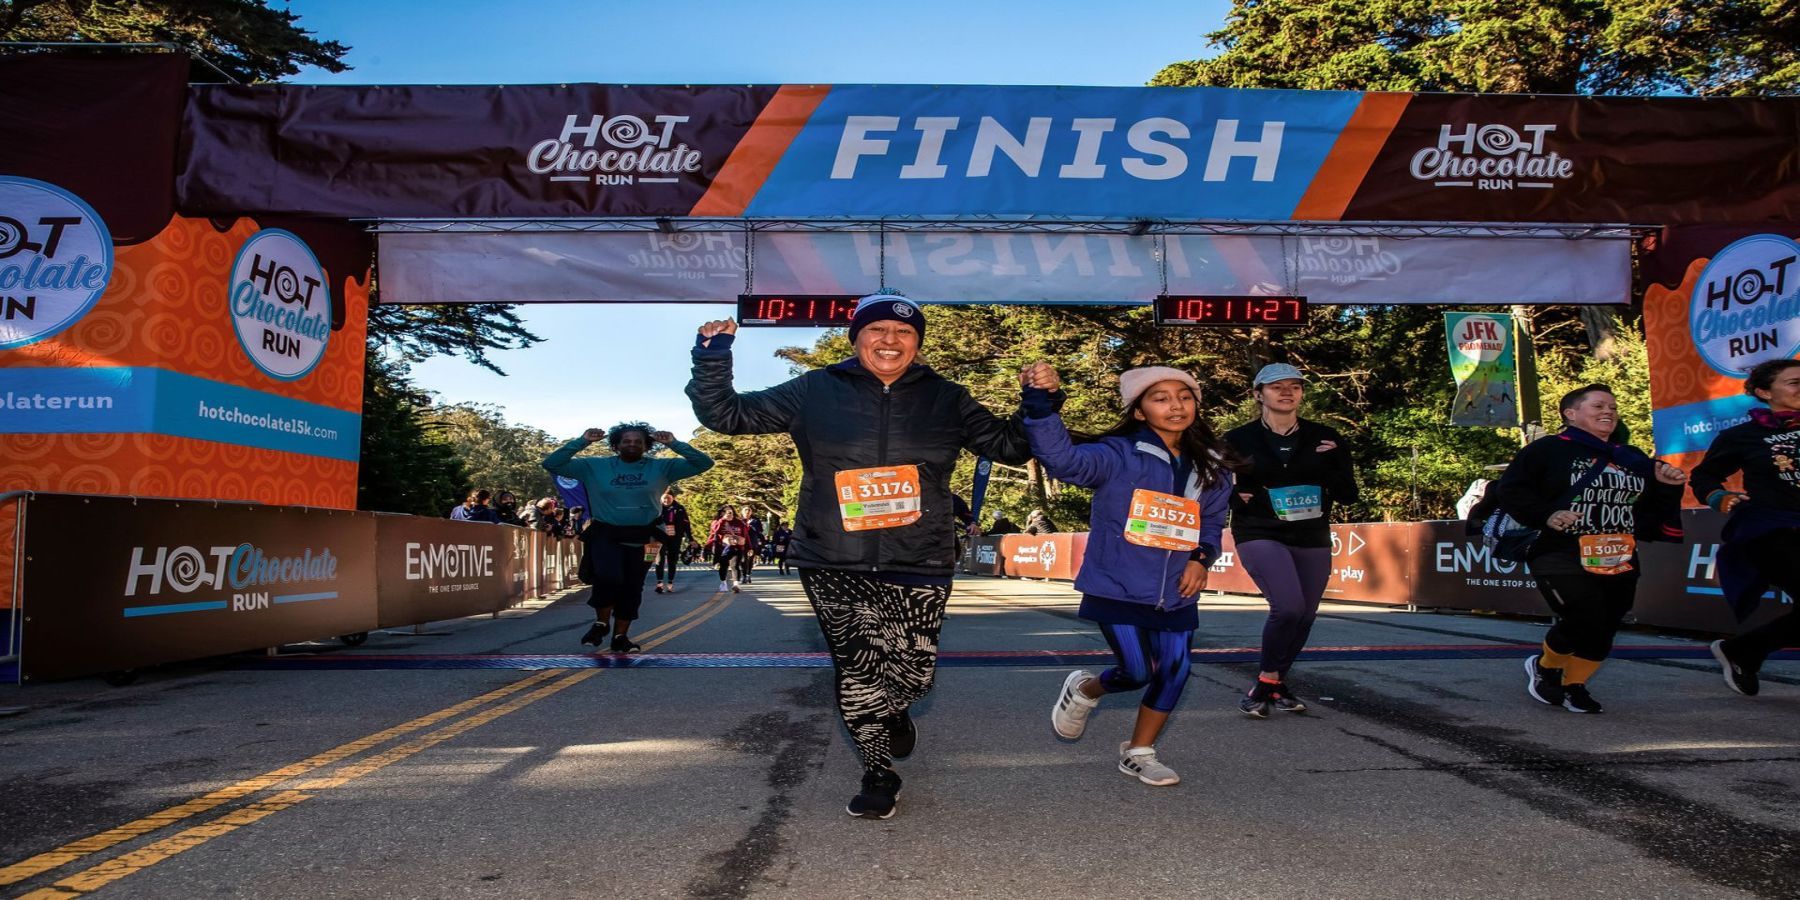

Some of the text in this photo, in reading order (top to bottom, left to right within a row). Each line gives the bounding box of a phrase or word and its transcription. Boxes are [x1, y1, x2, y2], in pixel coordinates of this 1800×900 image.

[559, 115, 690, 149] HOT
[1438, 123, 1557, 155] HOT
[527, 139, 702, 174] Chocolate
[830, 116, 1286, 182] FINISH
[1410, 147, 1574, 180] Chocolate
[596, 174, 633, 186] RUN
[1478, 179, 1513, 190] RUN
[0, 216, 82, 258] OT
[250, 253, 321, 311] HOT
[1706, 256, 1797, 311] HOT
[233, 279, 328, 342] Chocolate
[1694, 287, 1800, 344] Chocolat
[262, 329, 301, 360] RUN
[1462, 321, 1499, 341] JFK
[1729, 328, 1779, 358] RUN
[198, 400, 338, 441] hotchocolate15k.com
[859, 481, 913, 498] 31176
[1570, 473, 1603, 487] MST
[1285, 495, 1319, 507] 51263
[1583, 488, 1630, 504] TO PET ALL
[1148, 506, 1196, 525] 31573
[1601, 504, 1634, 527] DOGS
[124, 543, 338, 596] HOT Chocolate
[1341, 565, 1364, 582] play
[1466, 578, 1481, 586] THE
[1483, 579, 1500, 587] ONE
[1502, 580, 1523, 588] STOP
[233, 592, 270, 612] RUN
[429, 585, 439, 593] THE
[440, 585, 450, 593] ONE
